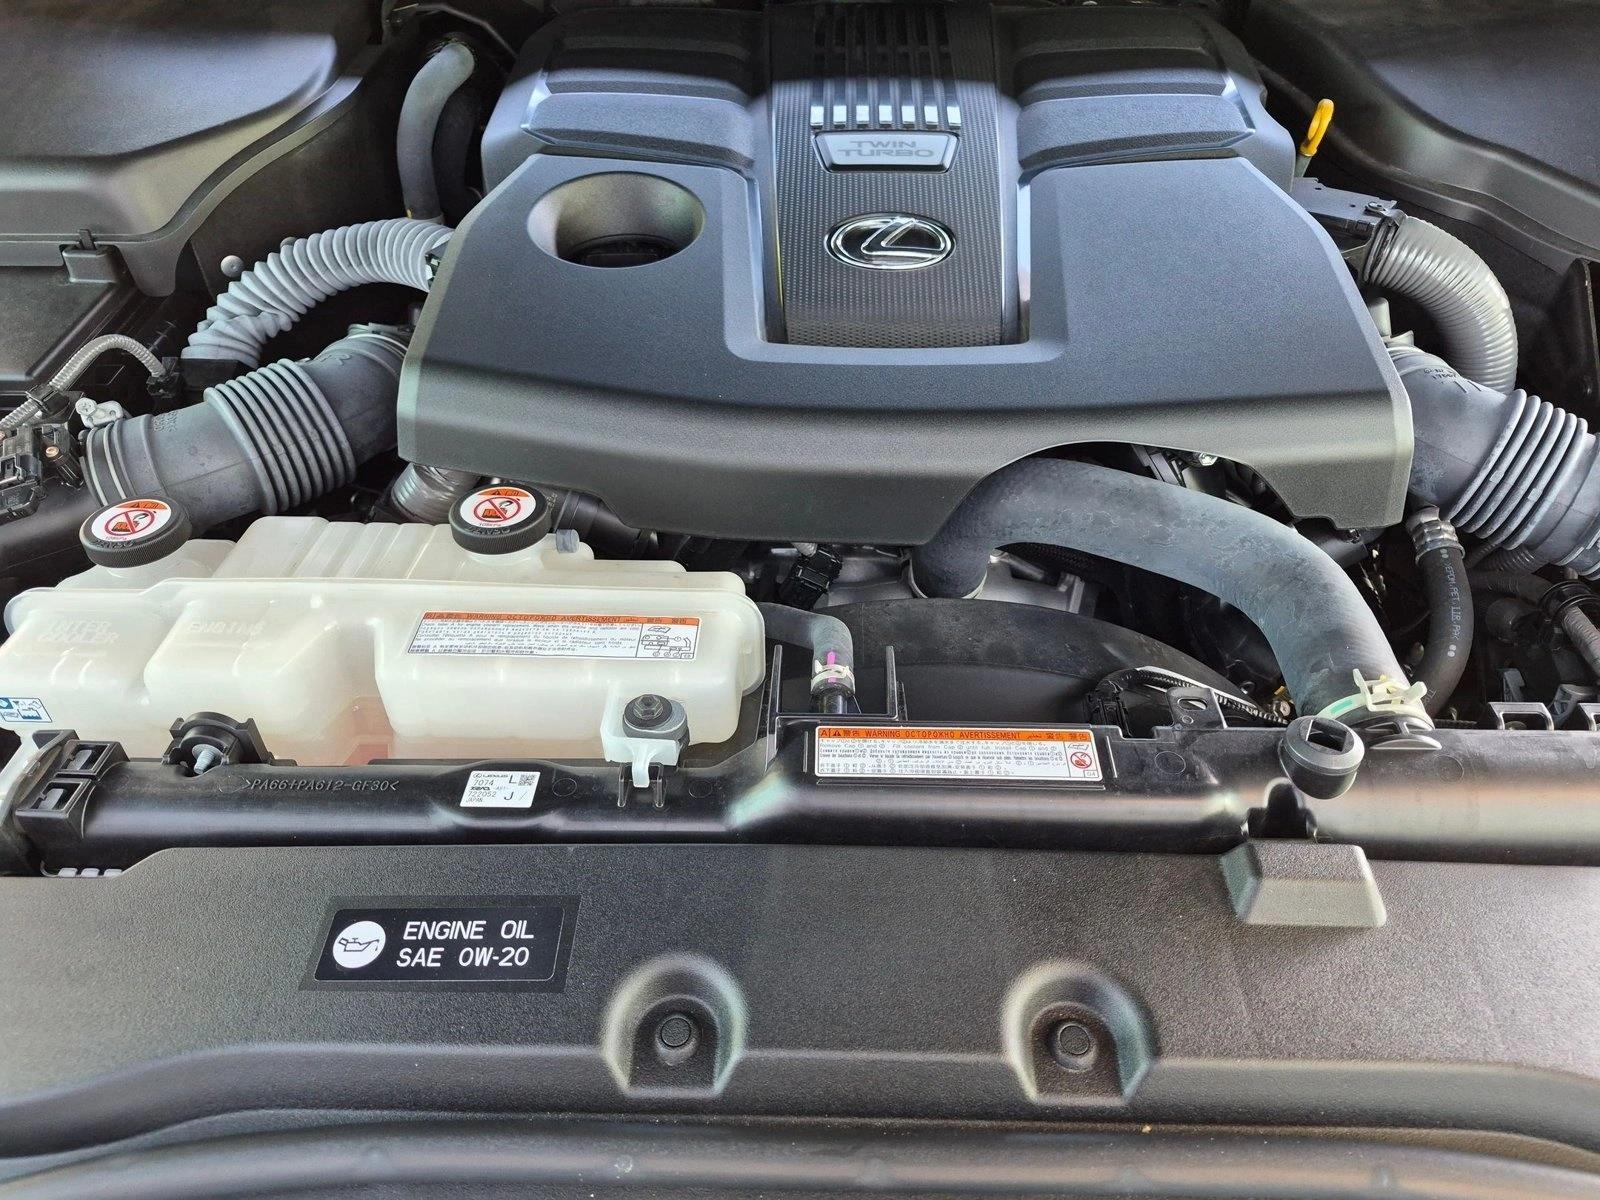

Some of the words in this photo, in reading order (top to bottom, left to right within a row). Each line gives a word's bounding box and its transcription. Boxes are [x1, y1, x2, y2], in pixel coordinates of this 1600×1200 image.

[849, 140, 917, 149] TWIN
[838, 149, 936, 158] TURBO
[466, 612, 500, 620] WARNING
[47, 620, 112, 633] INTER
[187, 621, 267, 635] ENGINE
[38, 632, 121, 643] COOLER
[865, 730, 901, 738] WARNING
[959, 731, 1021, 740] AVERTISSEMENT
[508, 774, 517, 784] L
[504, 791, 514, 801] J
[402, 919, 487, 940] ENGINE
[500, 919, 534, 939] OIL
[395, 947, 445, 967] SAE
[457, 946, 530, 967] 0W-20
